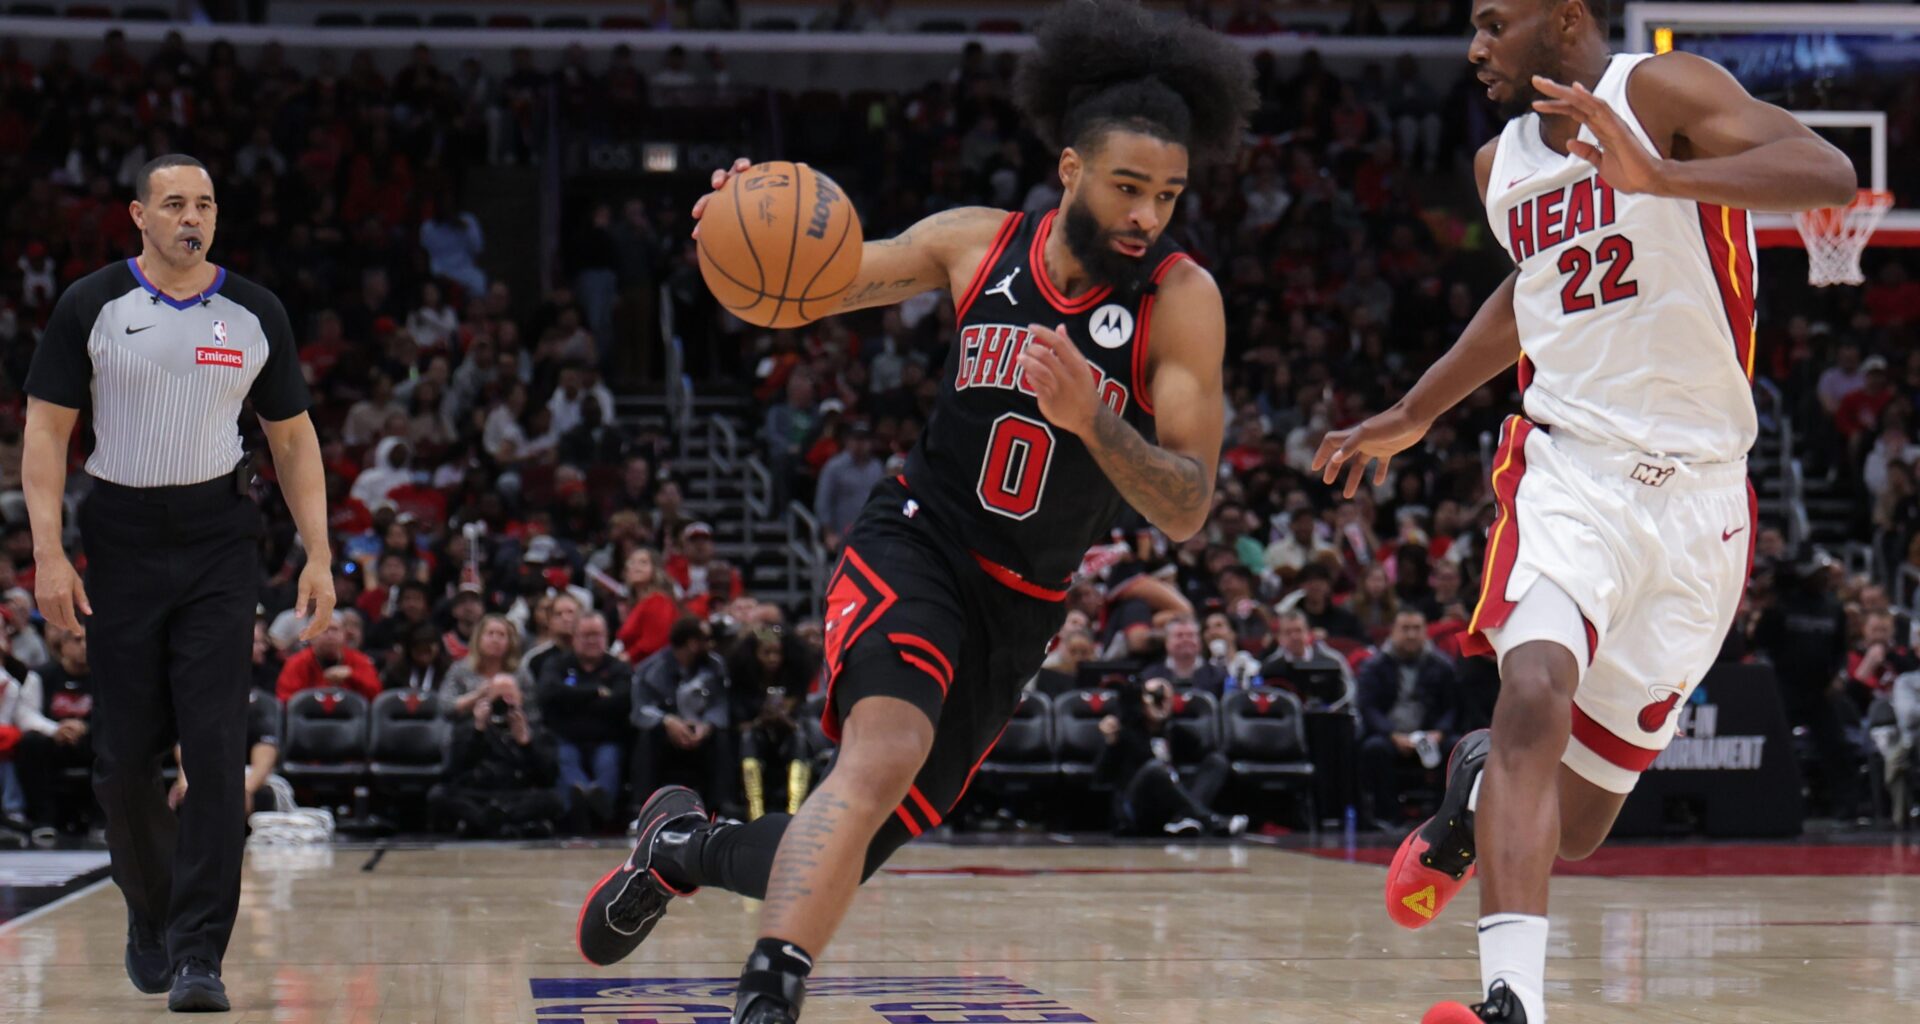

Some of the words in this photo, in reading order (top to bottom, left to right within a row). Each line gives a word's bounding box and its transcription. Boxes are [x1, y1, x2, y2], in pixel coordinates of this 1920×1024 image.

[806, 171, 839, 239] ilson
[1508, 173, 1616, 264] HEAT
[1557, 233, 1638, 315] 22
[197, 350, 242, 364] Emirates
[955, 323, 1129, 420] CHIO
[977, 411, 1056, 521] 0
[1648, 735, 1767, 770] OURNAMENT
